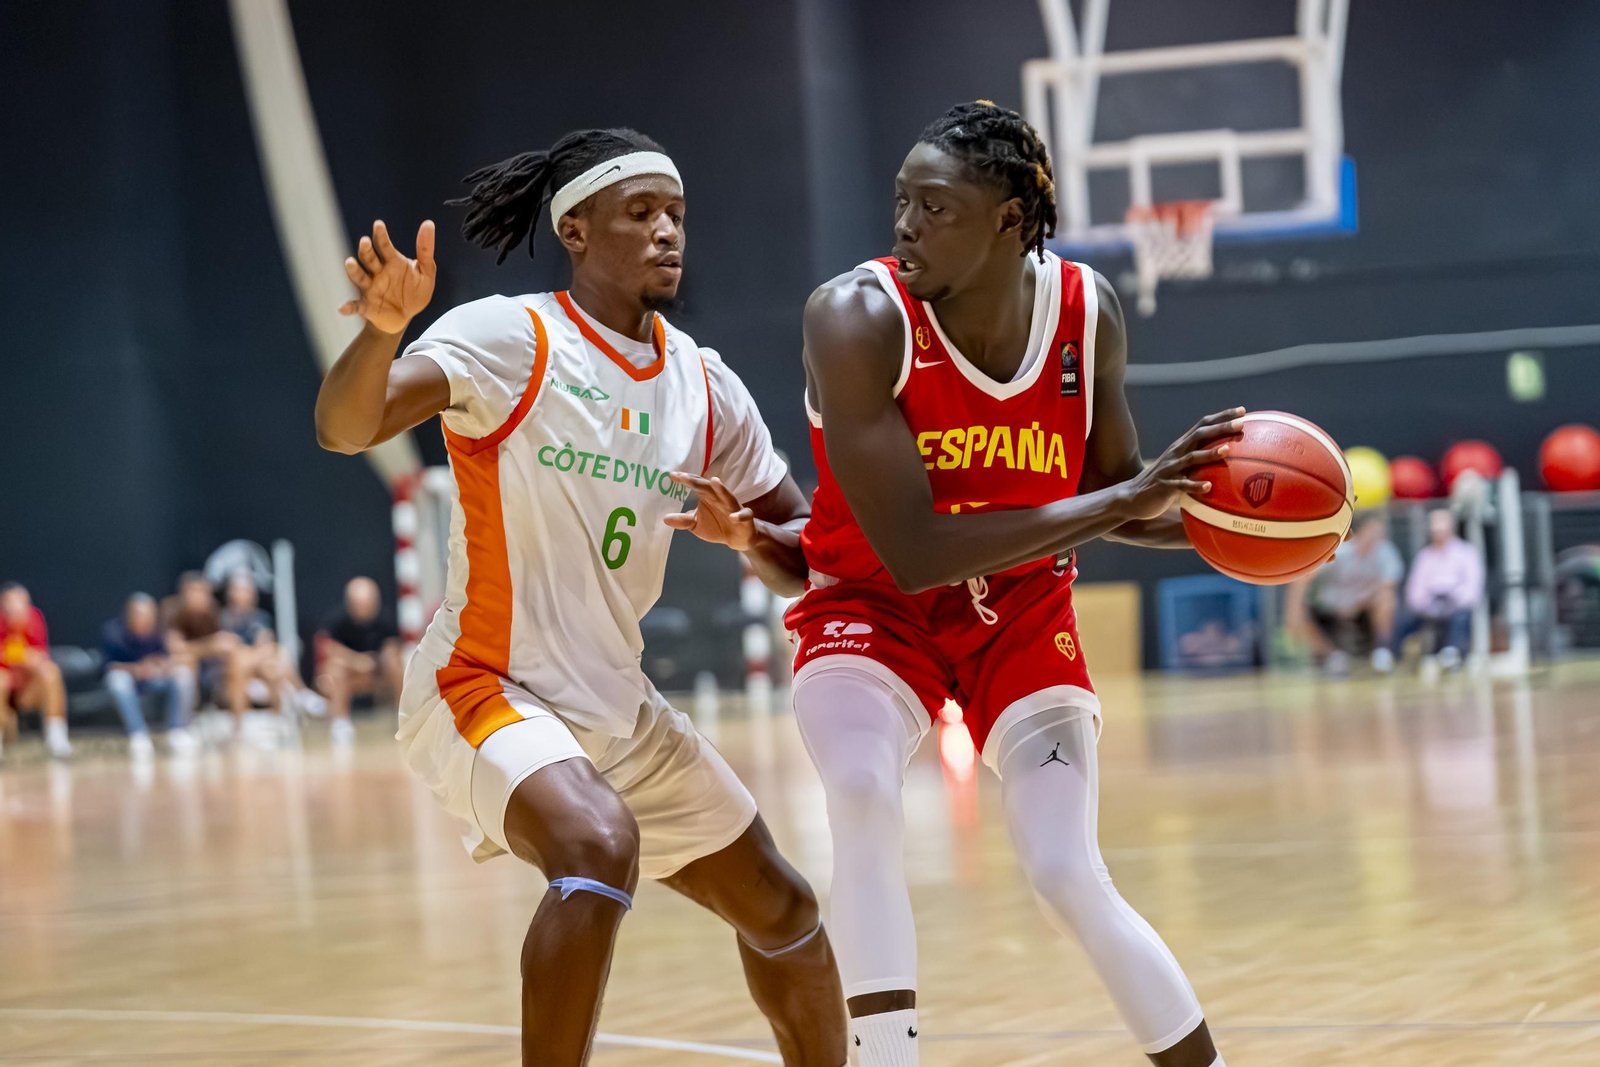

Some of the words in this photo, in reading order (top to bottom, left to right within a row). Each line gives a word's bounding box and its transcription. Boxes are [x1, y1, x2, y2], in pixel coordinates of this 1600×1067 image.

[1061, 372, 1076, 383] FIBA
[537, 442, 611, 480] CÔTE
[916, 421, 1067, 479] ESPAÑA
[601, 506, 637, 570] 6
